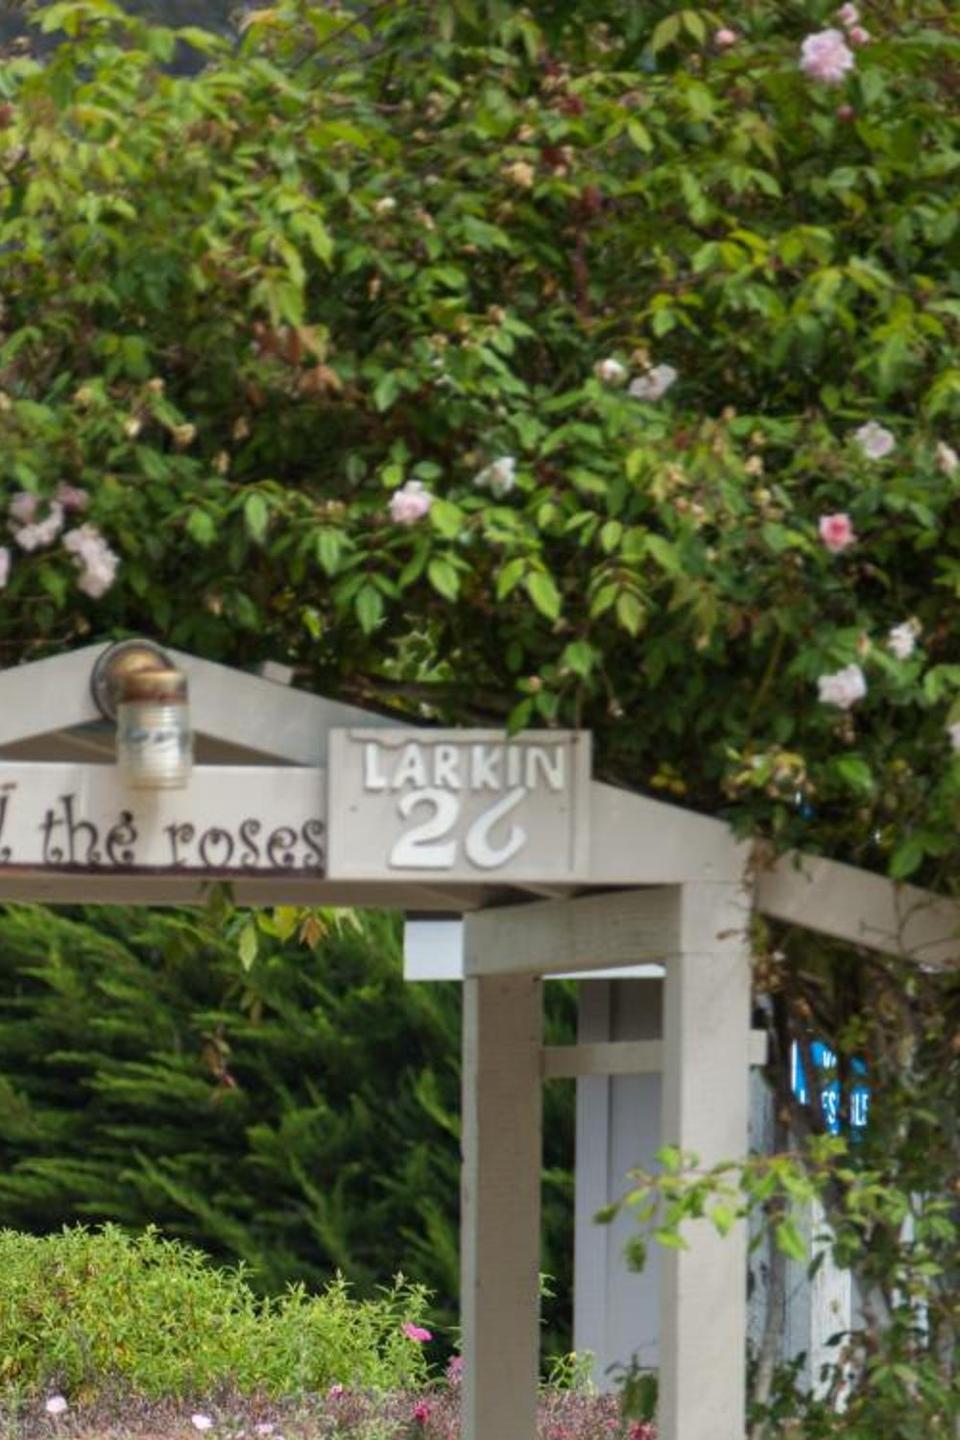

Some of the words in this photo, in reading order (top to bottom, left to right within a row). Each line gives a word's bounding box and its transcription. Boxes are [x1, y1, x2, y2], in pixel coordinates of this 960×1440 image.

[363, 741, 566, 790] LARKIN
[38, 793, 138, 866] the
[163, 818, 327, 868] roses
[388, 786, 528, 868] 26
